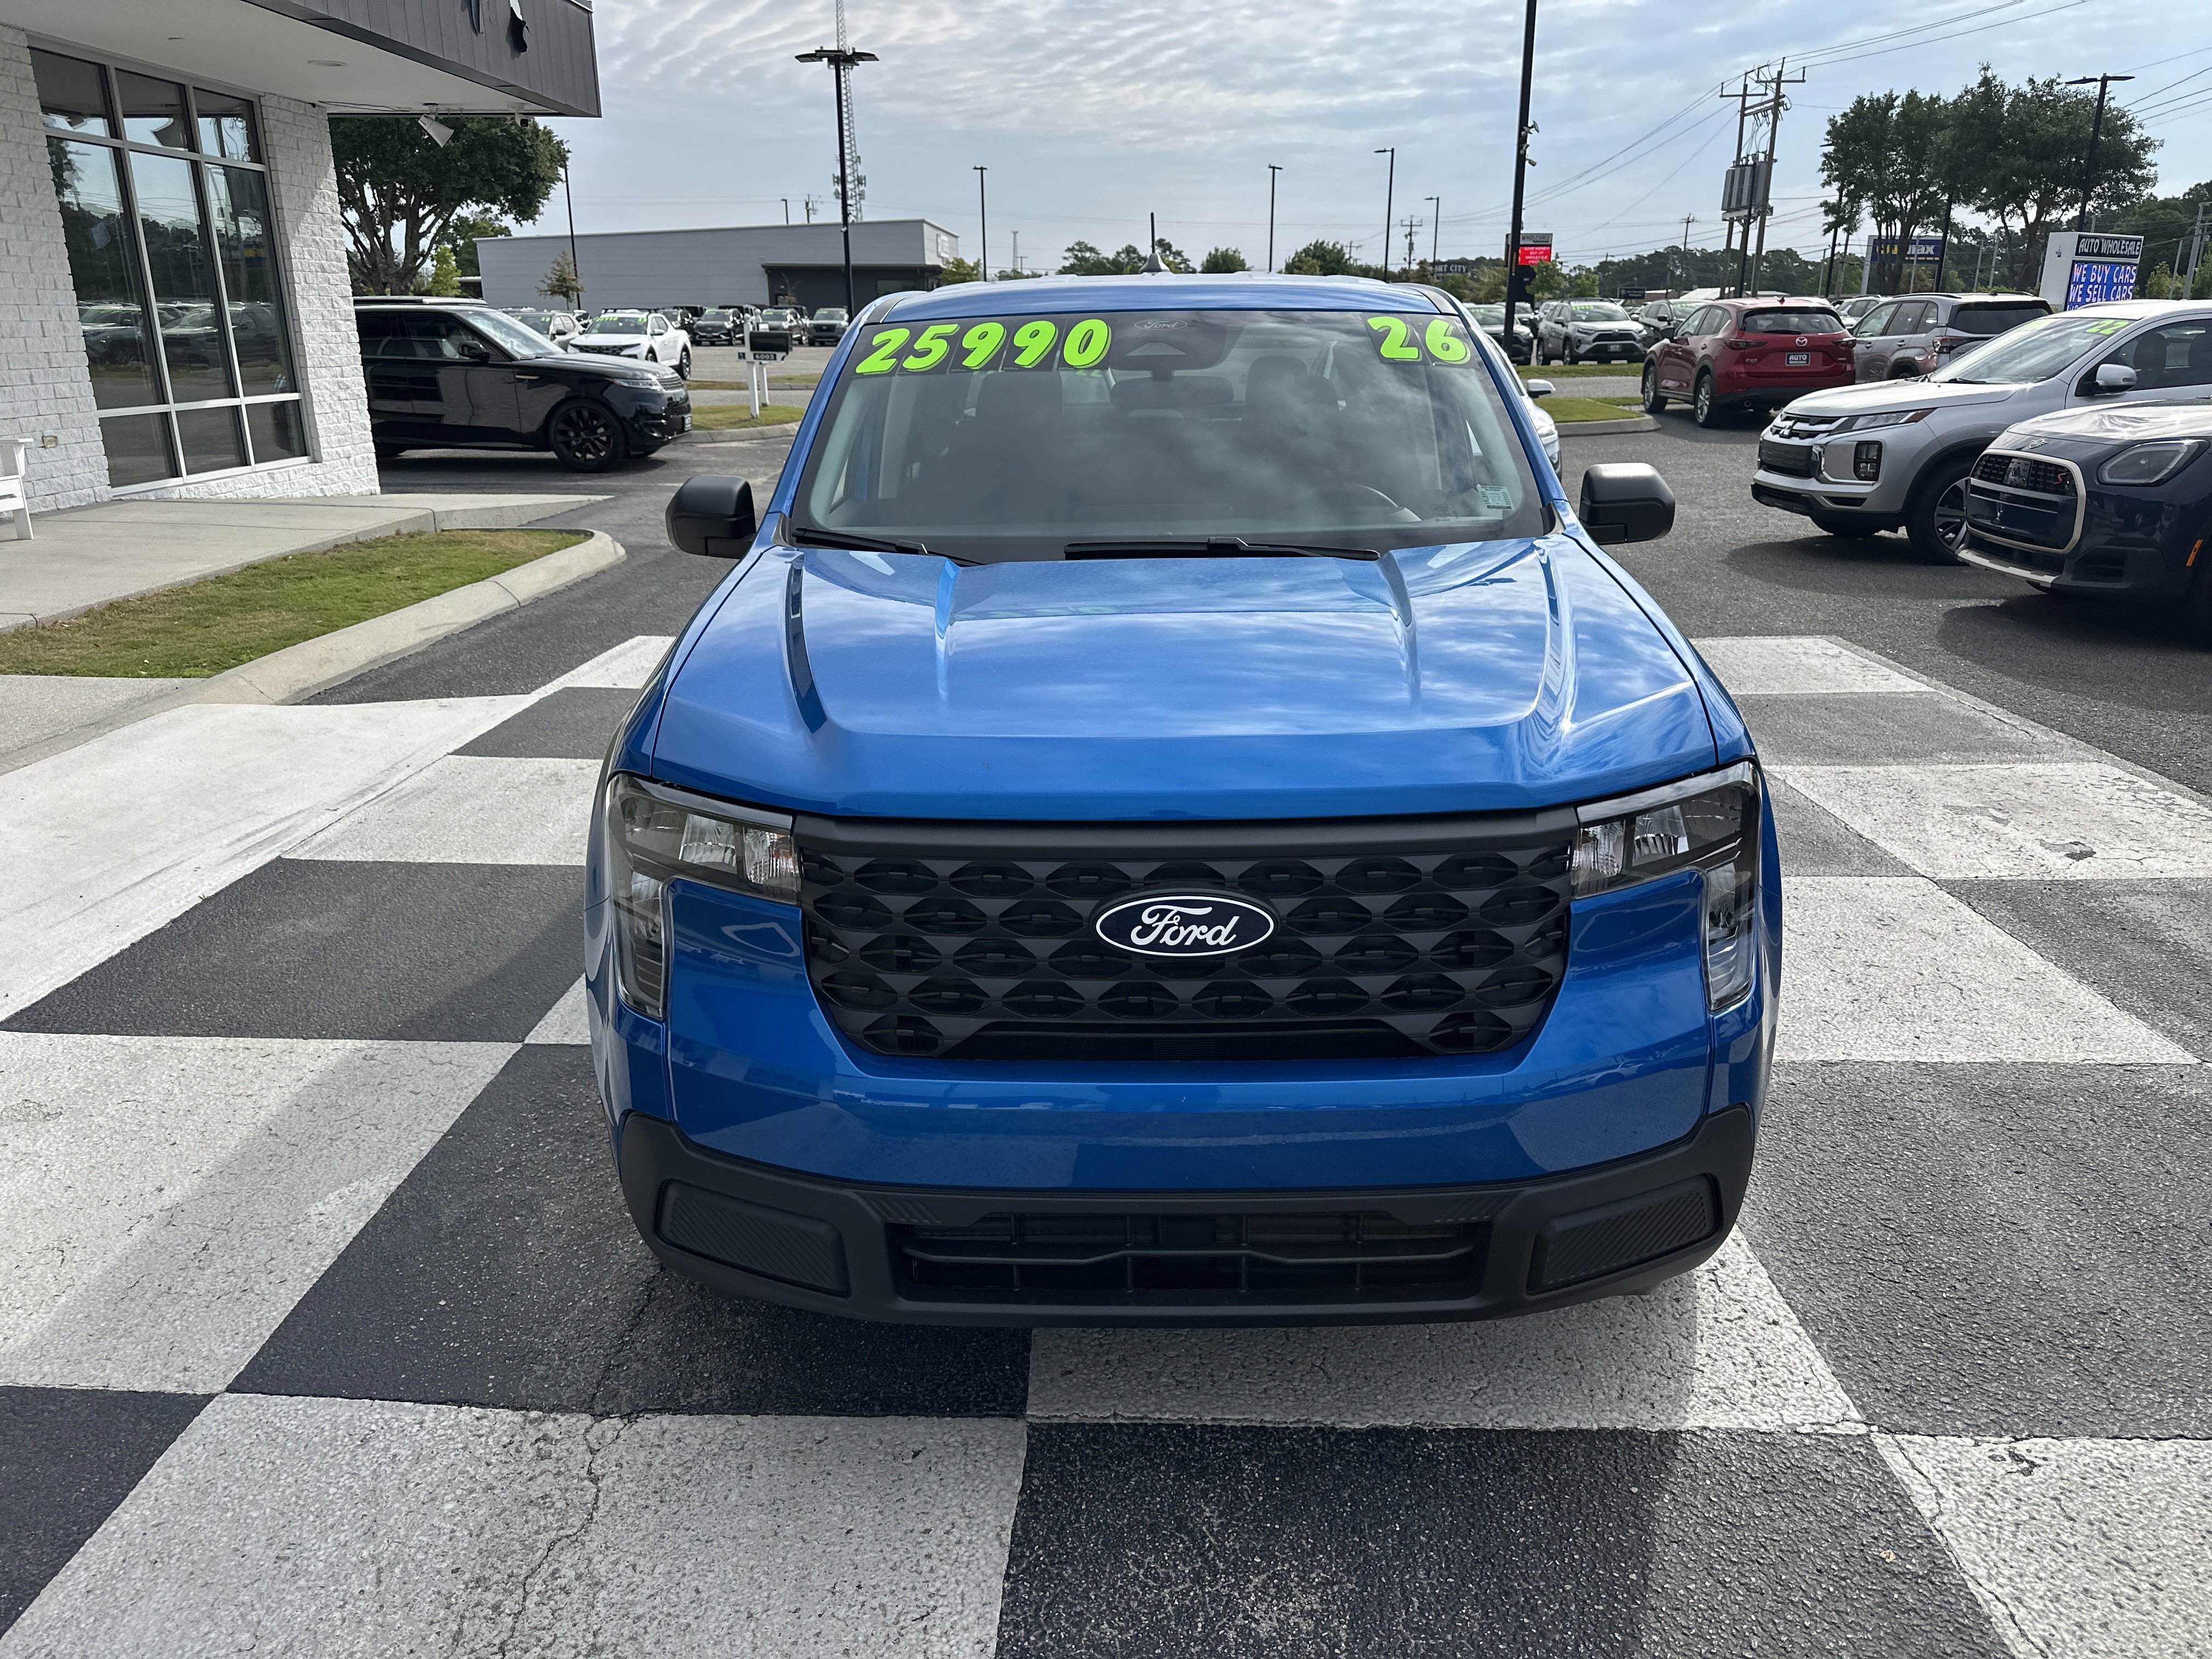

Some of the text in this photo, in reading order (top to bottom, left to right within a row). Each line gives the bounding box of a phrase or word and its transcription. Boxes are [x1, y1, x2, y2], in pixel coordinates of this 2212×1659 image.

[2079, 238, 2141, 256] AUTO WHOLESALE
[2073, 263, 2137, 284] WE BUY CARS
[2069, 284, 2134, 302] WE SELL CARS
[1144, 320, 1178, 329] Ford
[2085, 319, 2129, 335] 22
[855, 319, 1111, 376] 25990
[1367, 316, 1471, 364] 26
[1131, 905, 1240, 945] Ford
